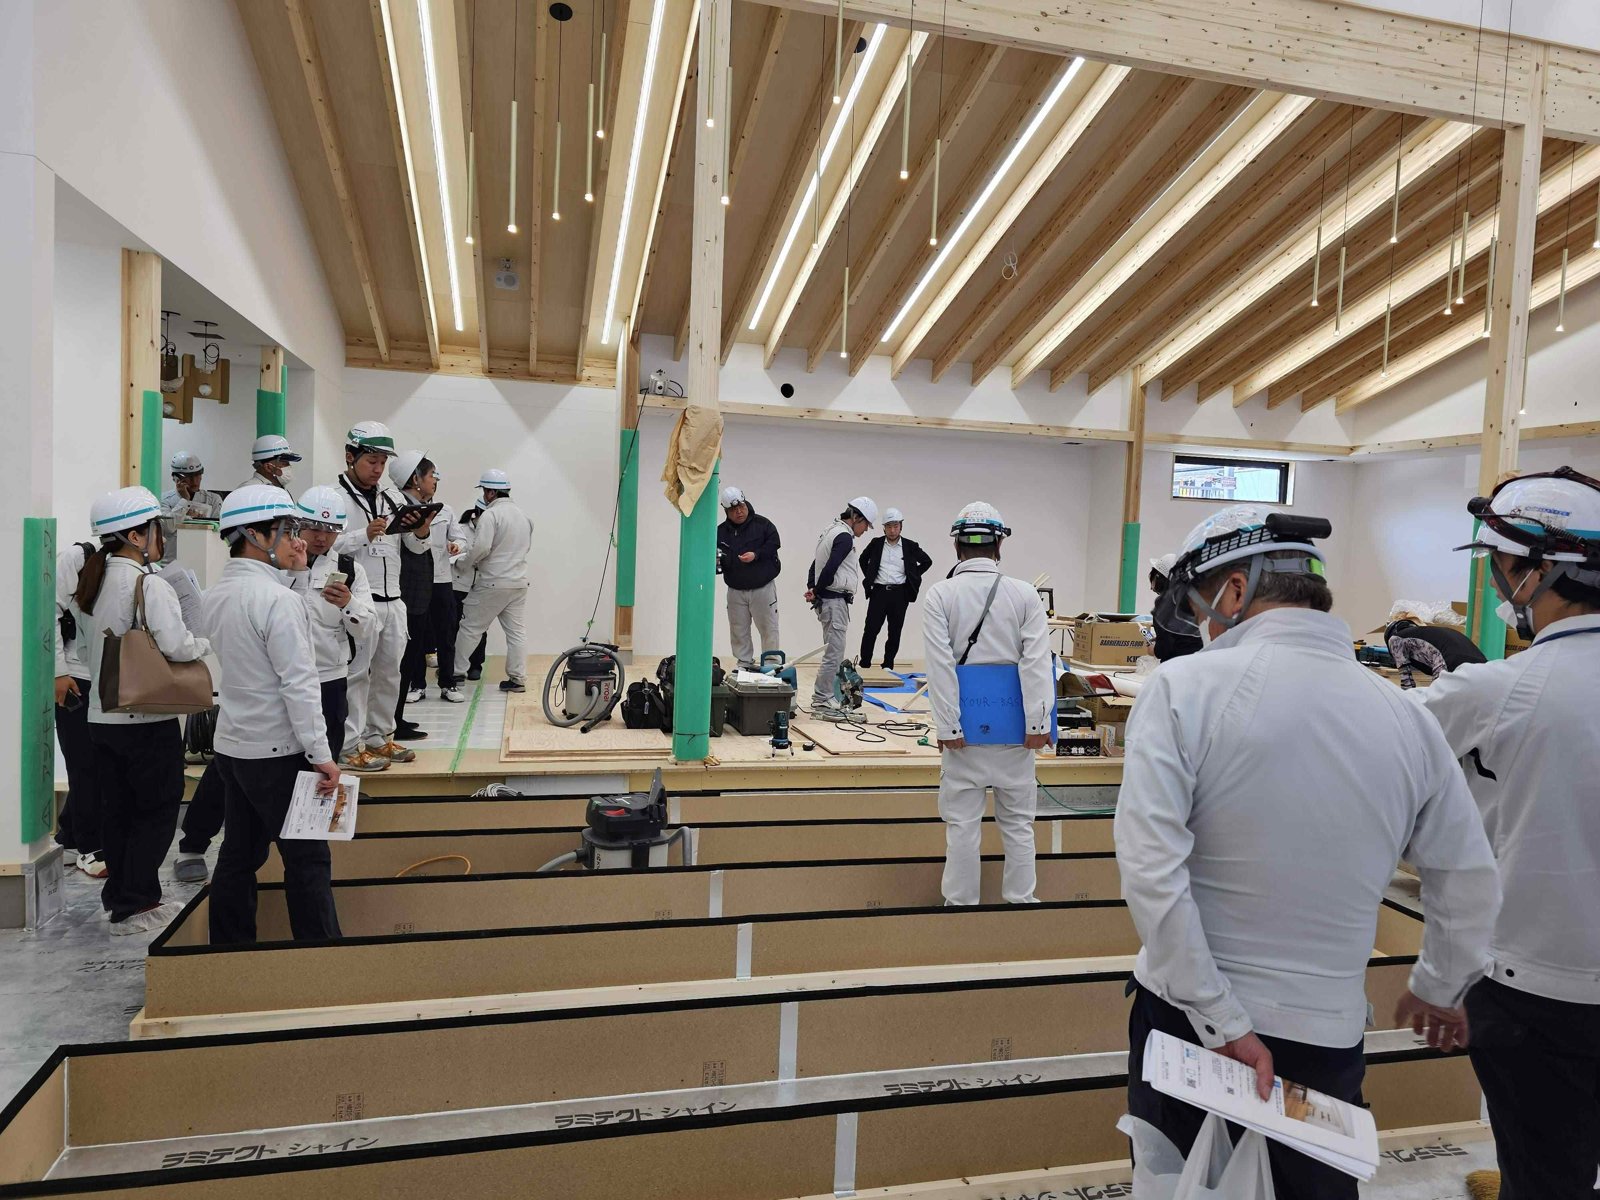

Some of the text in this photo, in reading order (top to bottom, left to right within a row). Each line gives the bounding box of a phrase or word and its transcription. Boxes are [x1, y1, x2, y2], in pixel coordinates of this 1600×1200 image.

[1099, 639, 1145, 648] BARRIERLESS FLOOR
[884, 1078, 971, 1096] ラミテクト
[554, 1101, 737, 1129] ラミテクト シャイン
[161, 1137, 380, 1169] ラミテクト シャイン
[1379, 1143, 1470, 1164] ラミテクト
